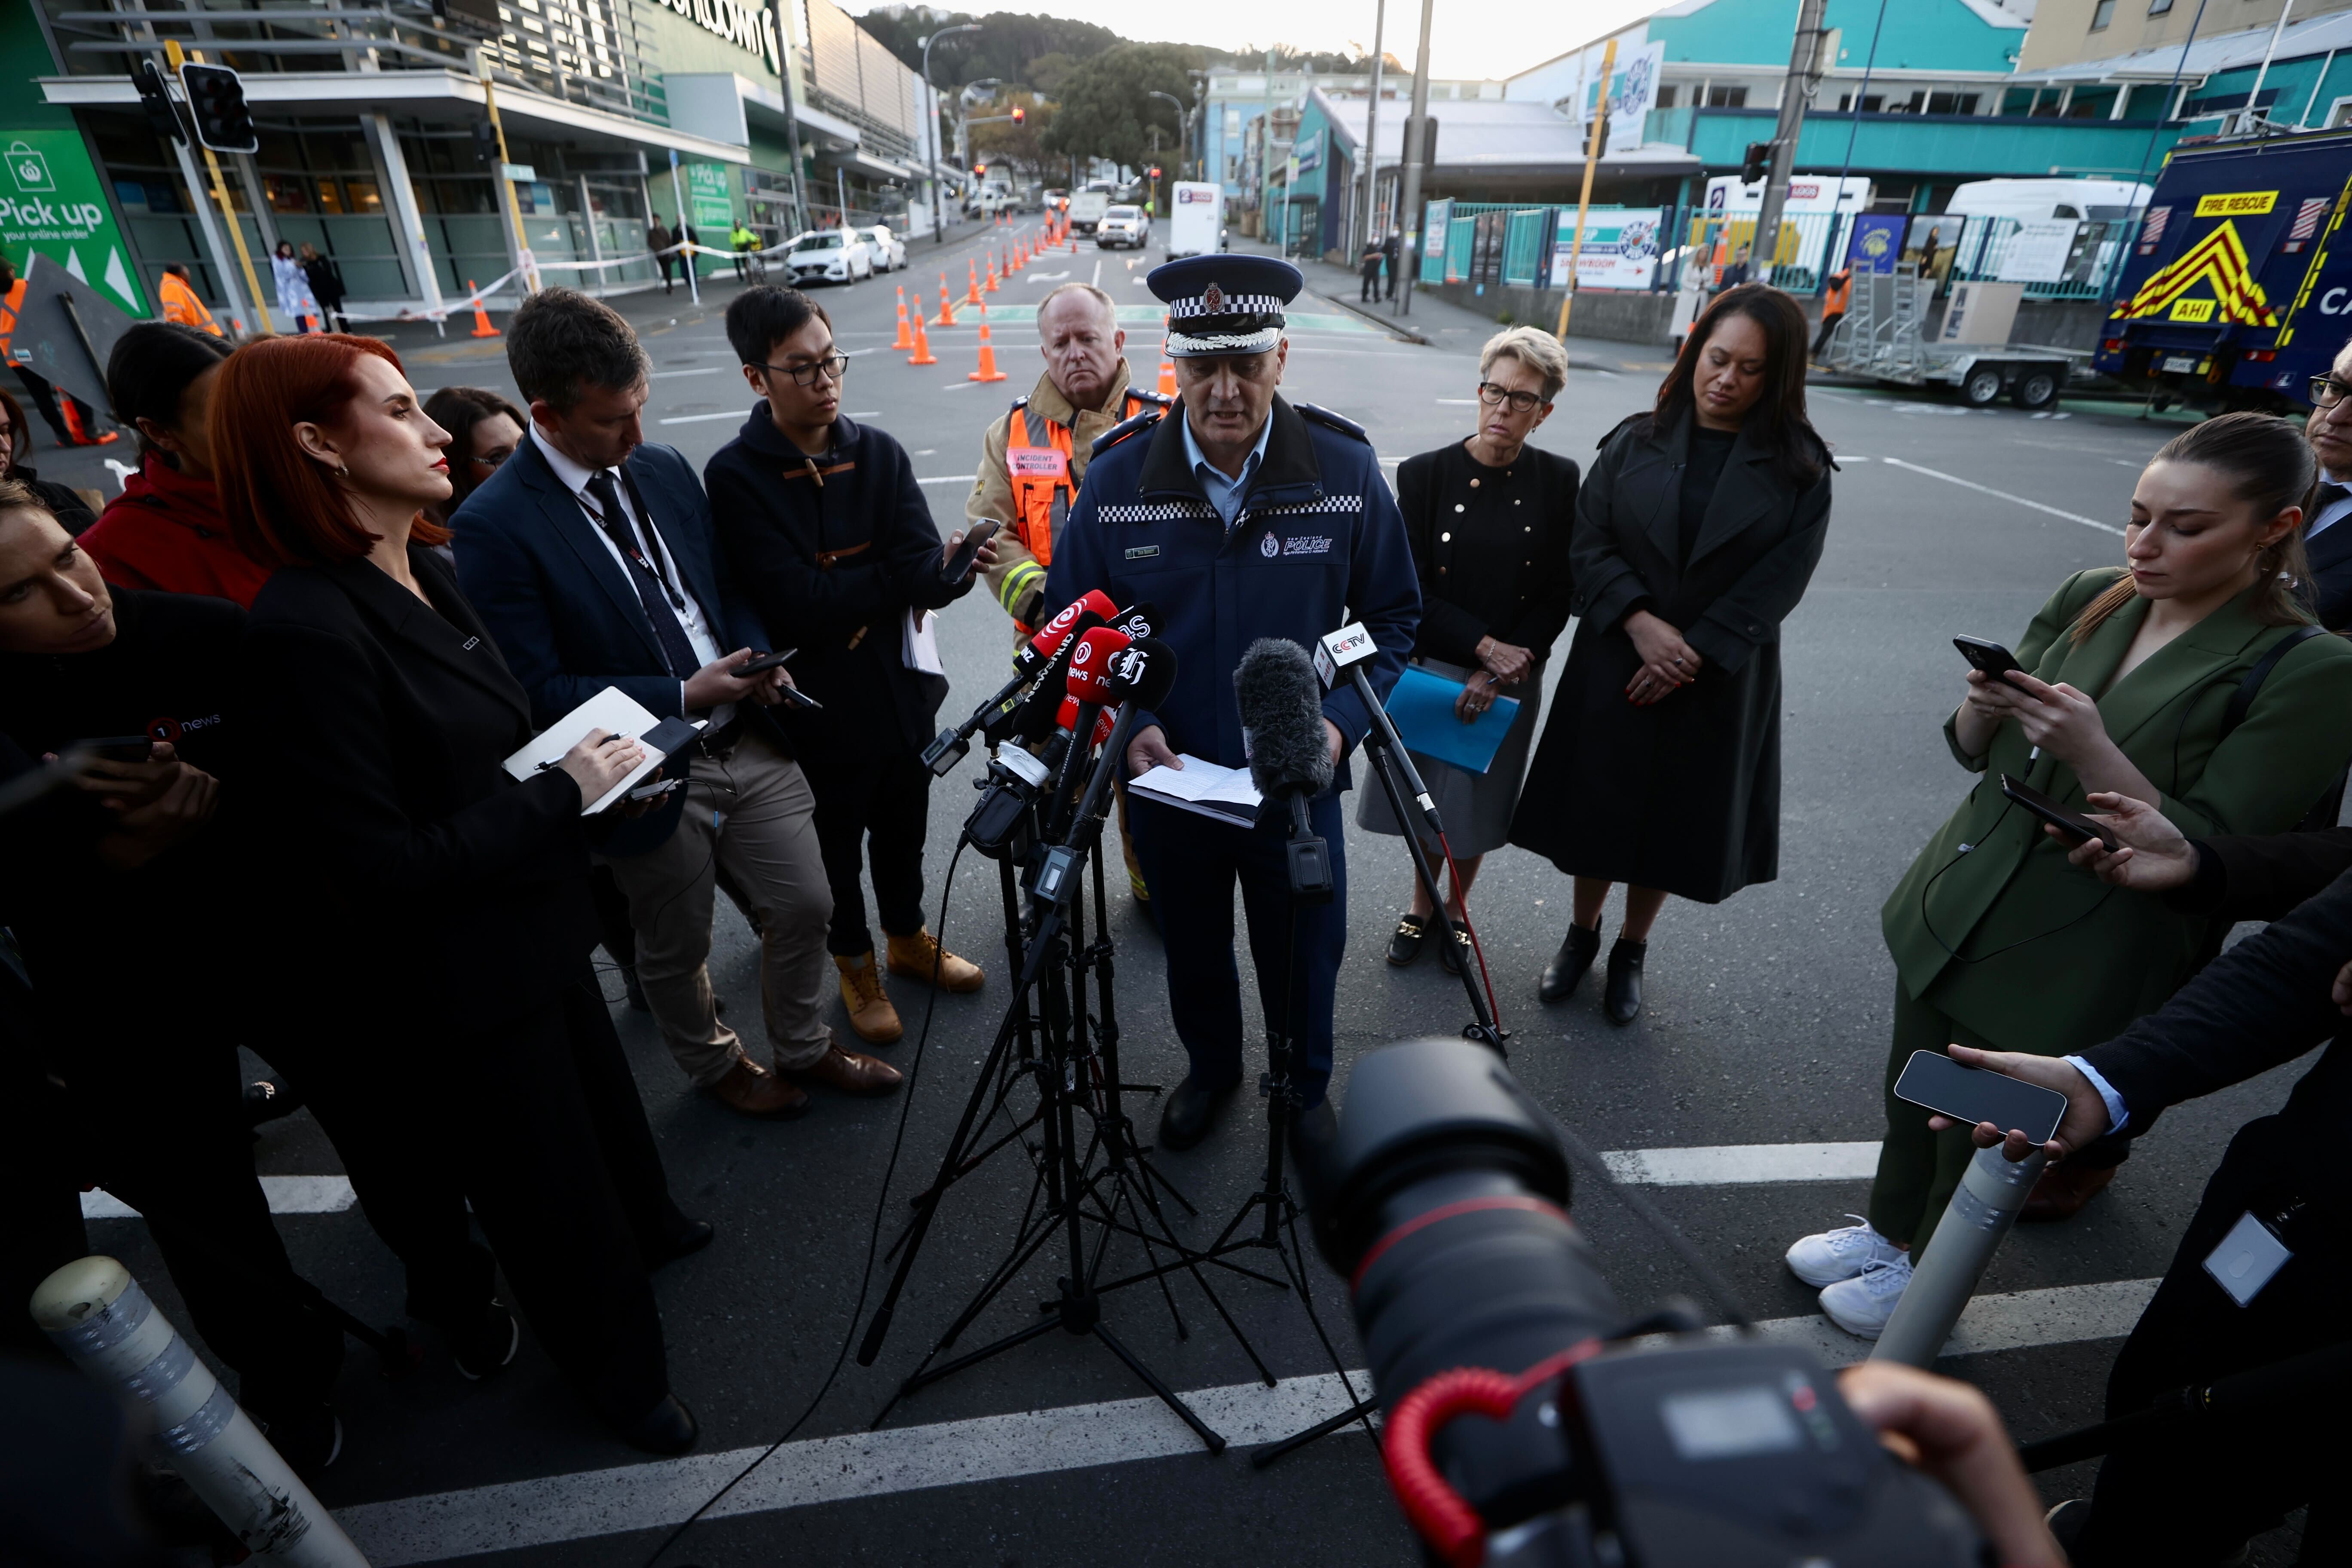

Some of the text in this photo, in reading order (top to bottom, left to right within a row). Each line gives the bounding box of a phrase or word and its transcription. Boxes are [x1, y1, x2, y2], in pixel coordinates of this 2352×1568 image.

[2201, 196, 2271, 212] FIRE RESCUE
[0, 196, 103, 233] Pick up
[3, 227, 89, 243] your online order
[1560, 258, 1616, 268] SHWROOM
[2177, 302, 2208, 318] AHI
[1284, 539, 1332, 551] POLICE
[1332, 633, 1365, 654] CCTV
[1068, 667, 1088, 681] news
[181, 714, 220, 732] news
[1097, 716, 1110, 737] ews
[1063, 740, 1074, 773] SENNHEISER
